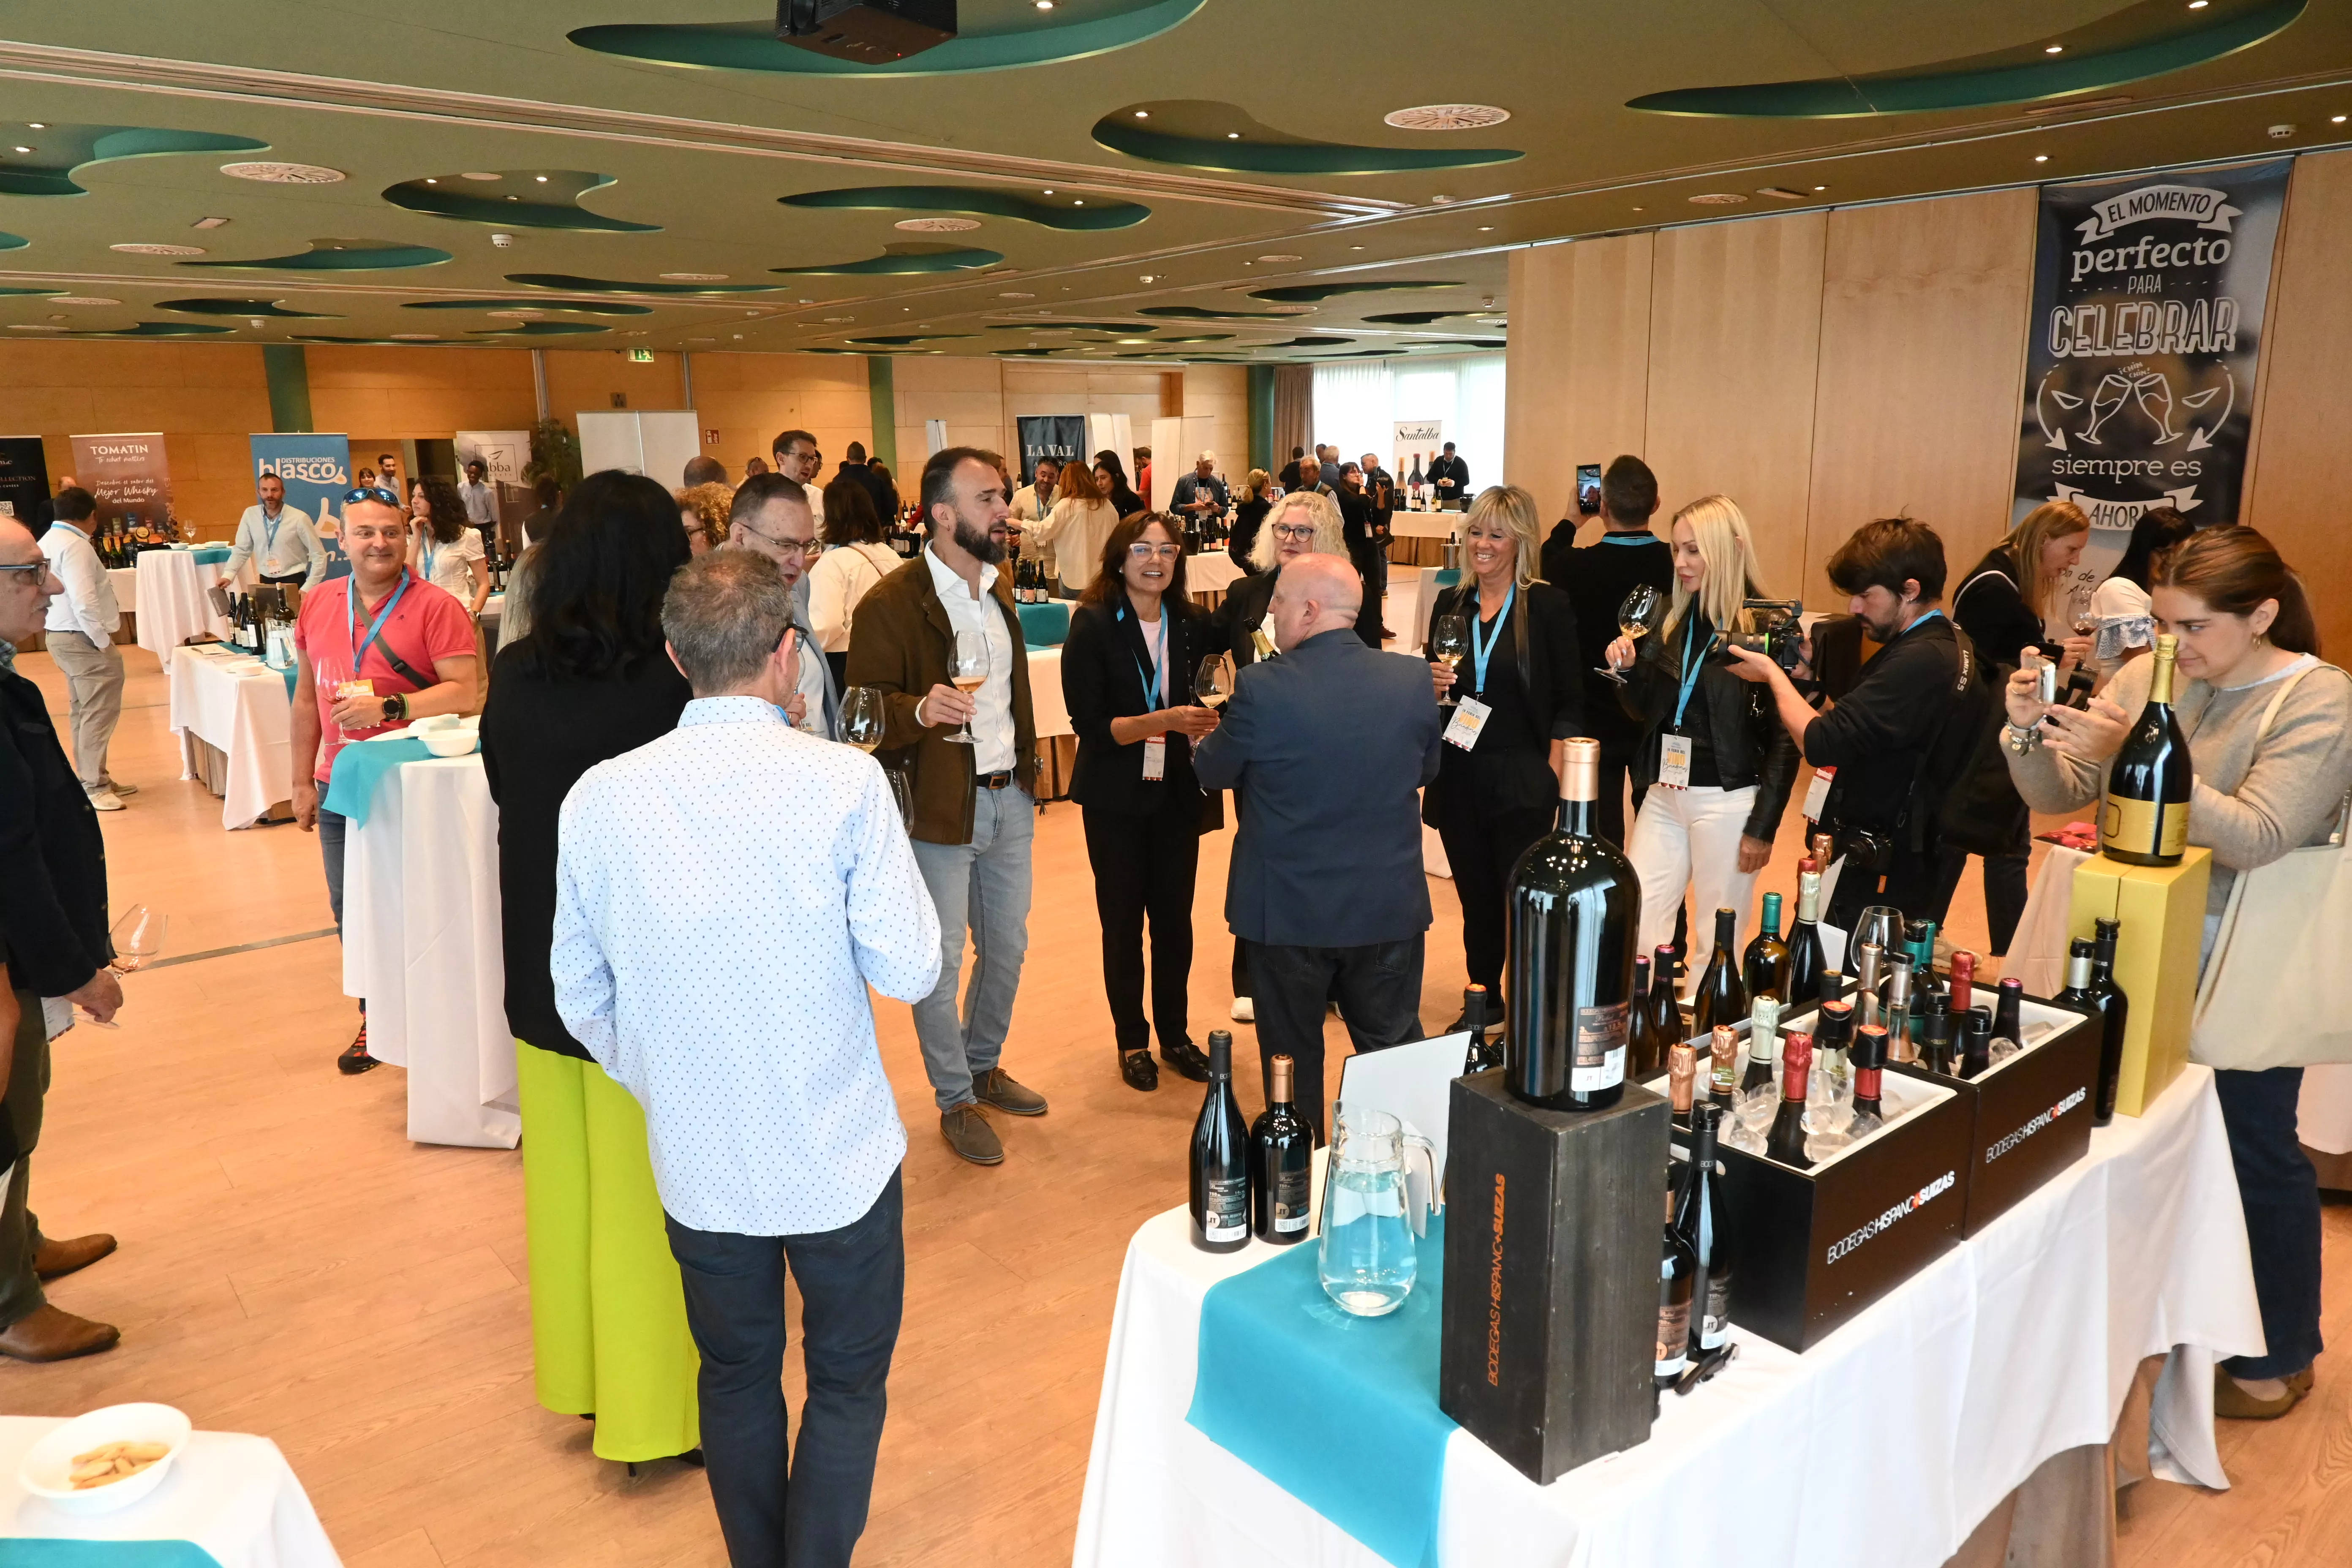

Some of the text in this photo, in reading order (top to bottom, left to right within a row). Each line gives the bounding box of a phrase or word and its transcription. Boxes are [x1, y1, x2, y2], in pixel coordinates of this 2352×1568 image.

[2107, 191, 2211, 223] EL MOMENTO
[2071, 235, 2232, 283] perfecto
[2126, 274, 2161, 294] PARA
[2048, 297, 2240, 358] CELEBRAR
[90, 444, 149, 455] TOMATIN
[1396, 426, 1440, 442] Santalba
[1026, 444, 1074, 456] LA VAL
[259, 458, 337, 479] blasco
[2051, 453, 2202, 484] siempre es
[94, 487, 120, 499] Mejor
[124, 486, 158, 496] Whisky
[1985, 1127, 2023, 1163] BODEGAS
[1827, 1221, 1875, 1264] BODEGAS
[1487, 1308, 1501, 1387] BODEGAS
